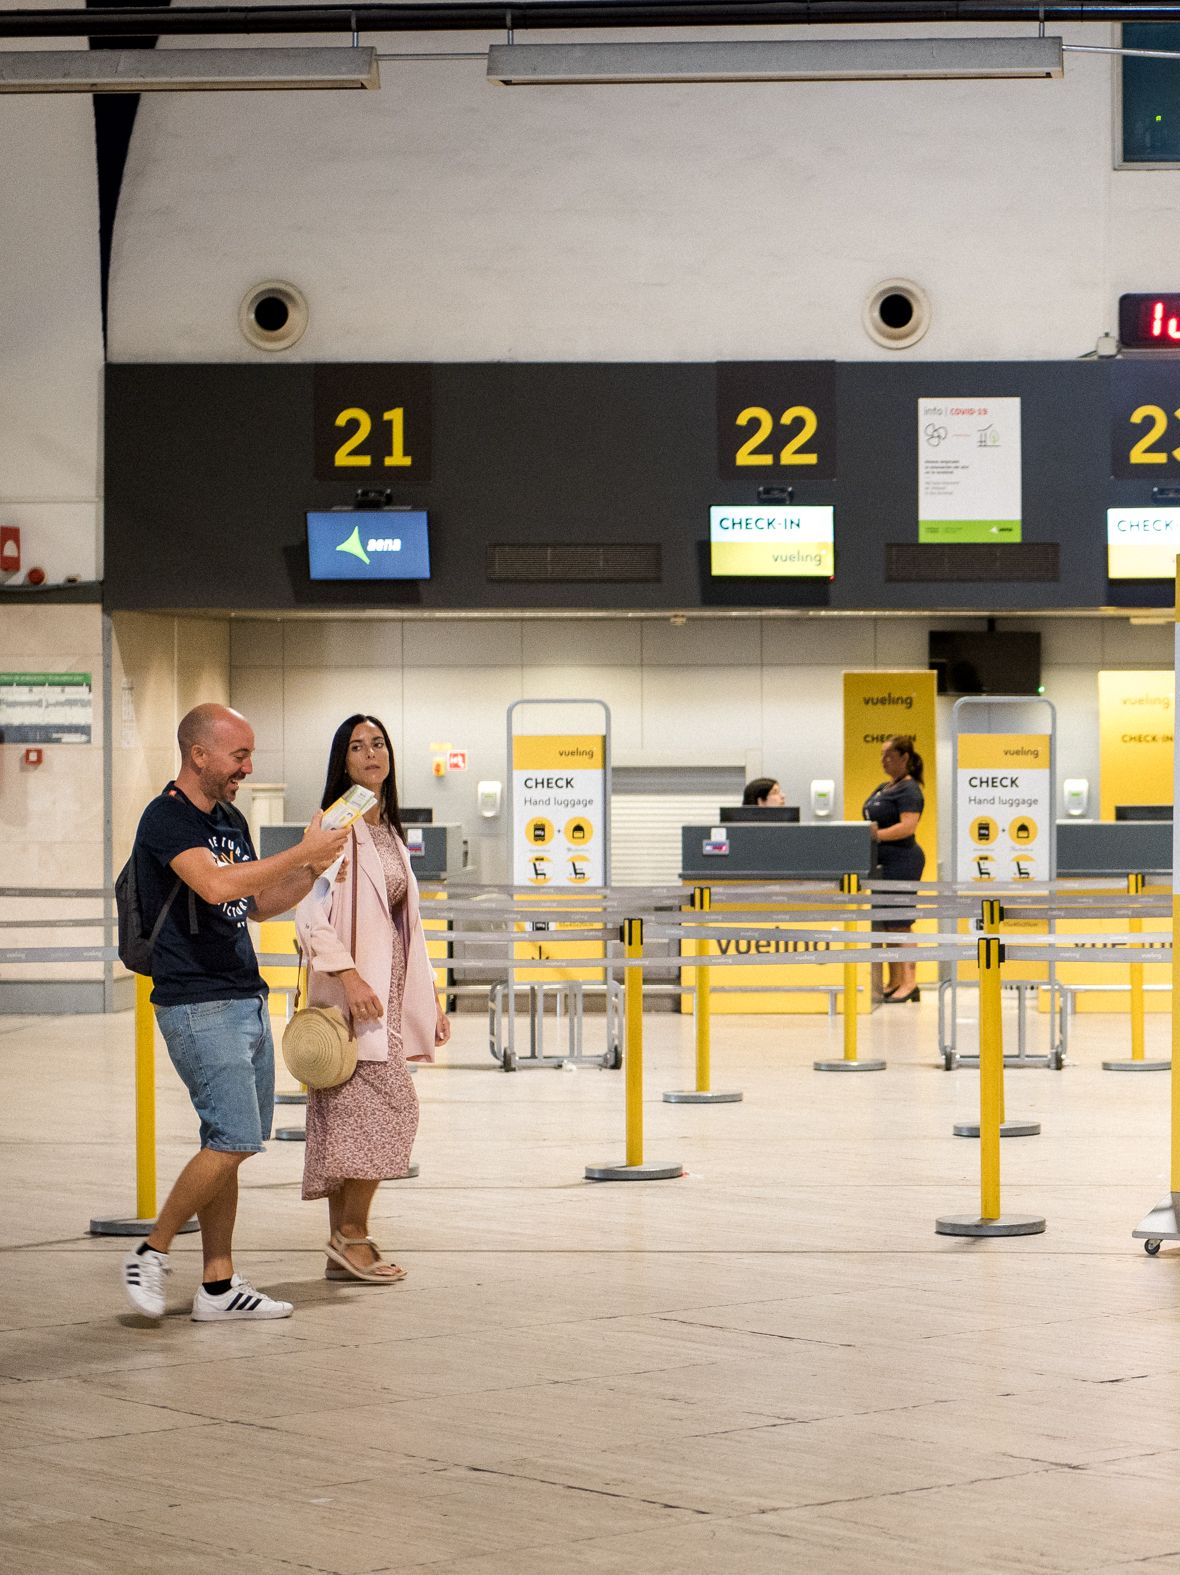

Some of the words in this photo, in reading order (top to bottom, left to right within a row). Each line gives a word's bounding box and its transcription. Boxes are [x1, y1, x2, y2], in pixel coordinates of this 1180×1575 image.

[334, 406, 412, 467] 21
[735, 405, 818, 466] 22
[719, 517, 801, 530] CHECK-IN
[772, 550, 822, 566] vueling
[863, 692, 914, 709] vueling
[558, 747, 594, 760] vueling
[1003, 746, 1039, 759] vueling
[524, 777, 575, 789] CHECK
[968, 776, 1020, 788] CHECK
[524, 797, 551, 807] Hand
[554, 797, 594, 809] luggage
[968, 796, 995, 806] Hand
[998, 796, 1039, 808] luggage
